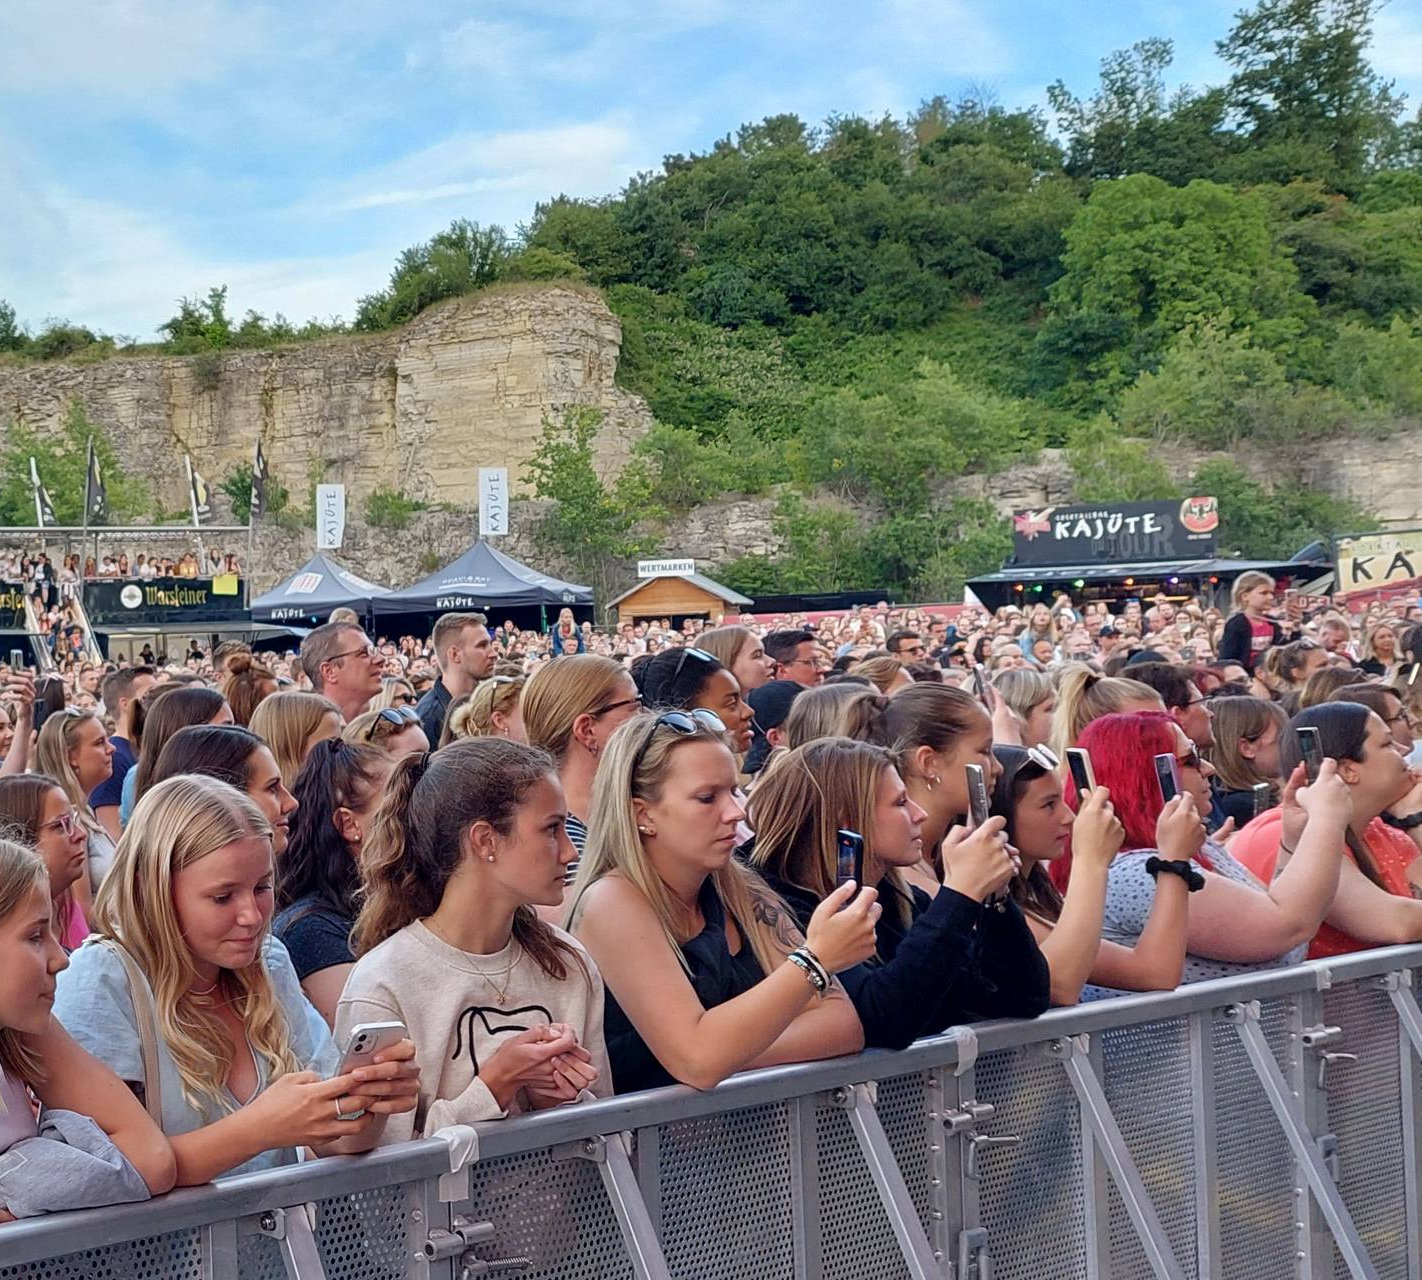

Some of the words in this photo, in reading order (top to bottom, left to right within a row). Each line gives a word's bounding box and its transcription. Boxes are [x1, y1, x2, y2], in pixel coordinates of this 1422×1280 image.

[1055, 512, 1162, 540] KAJÜTE
[639, 562, 694, 573] WERTMARKEN
[1352, 551, 1410, 584] KA
[144, 584, 208, 607] Warsteiner
